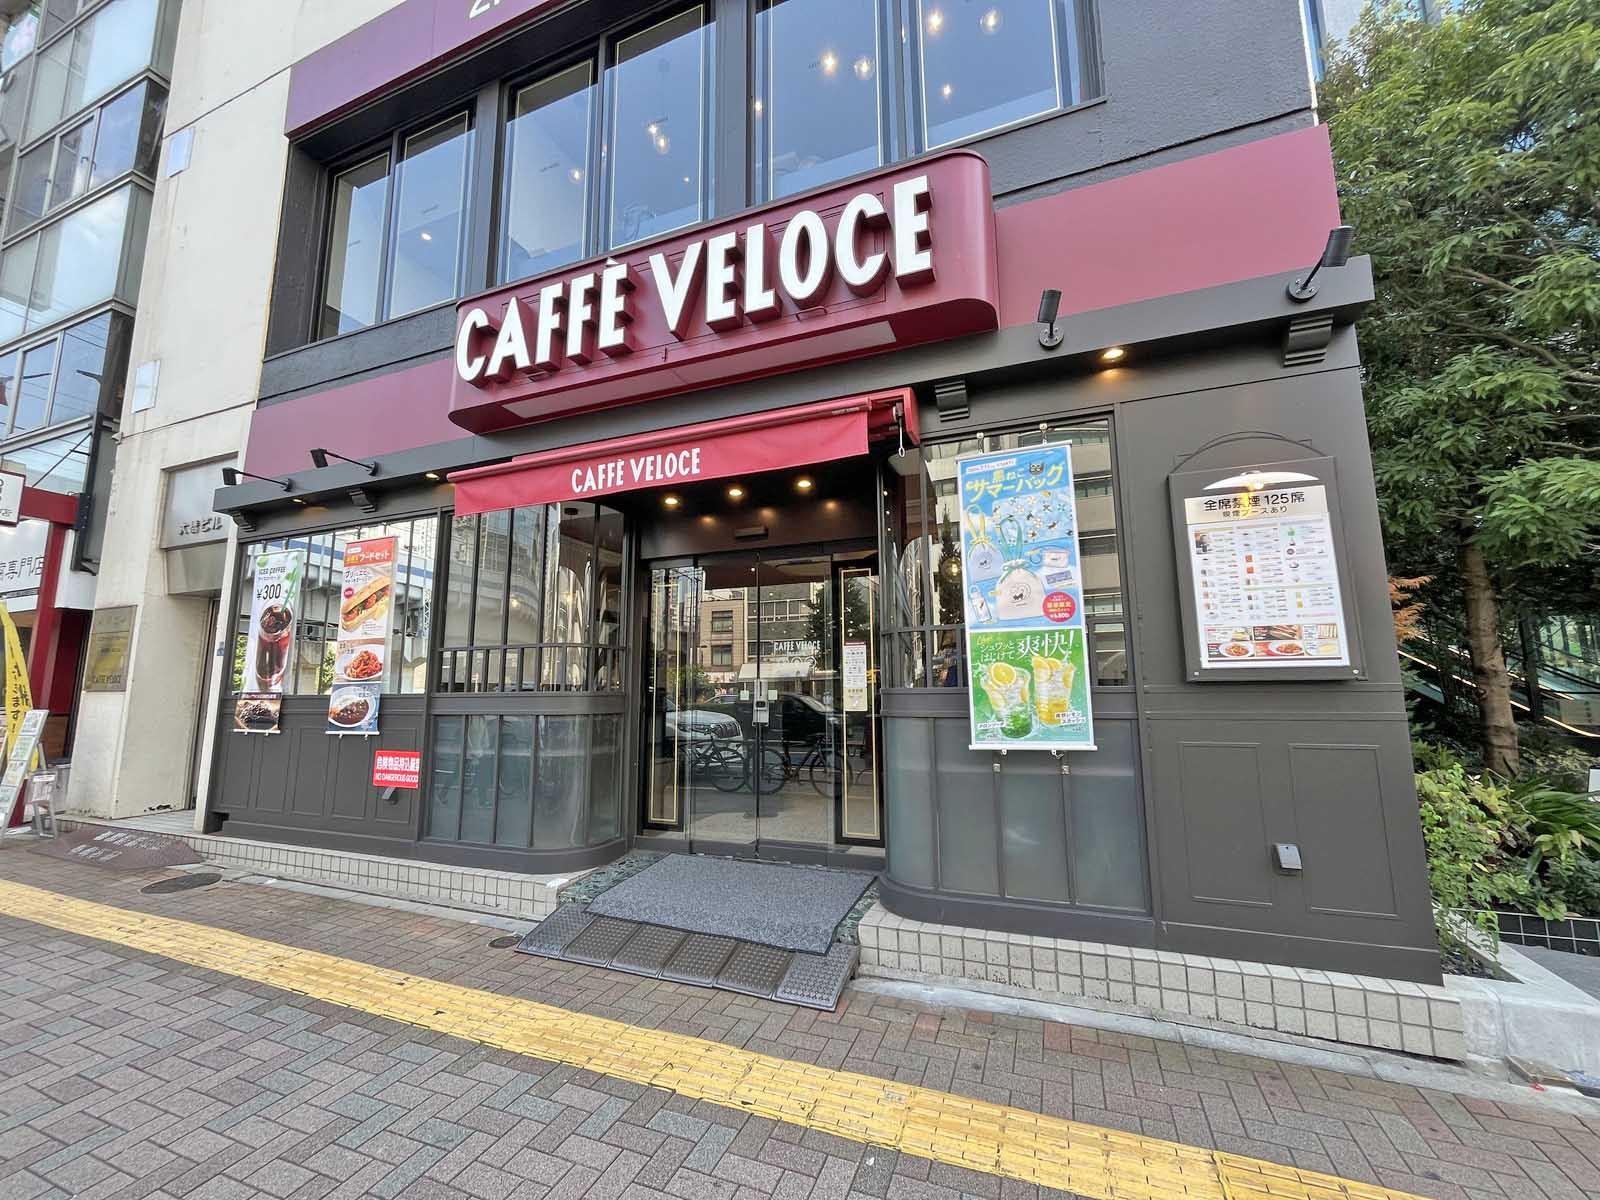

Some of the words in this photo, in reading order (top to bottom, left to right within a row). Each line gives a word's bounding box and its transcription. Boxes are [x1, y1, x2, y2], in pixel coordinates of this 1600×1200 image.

[649, 175, 933, 333] VELOCE
[630, 447, 701, 483] VELOCE
[1204, 495, 1261, 512] 全席禁煙
[1264, 491, 1305, 506] 125席
[1222, 505, 1288, 518] 喫煙ブースあり
[256, 583, 282, 601] ¥300
